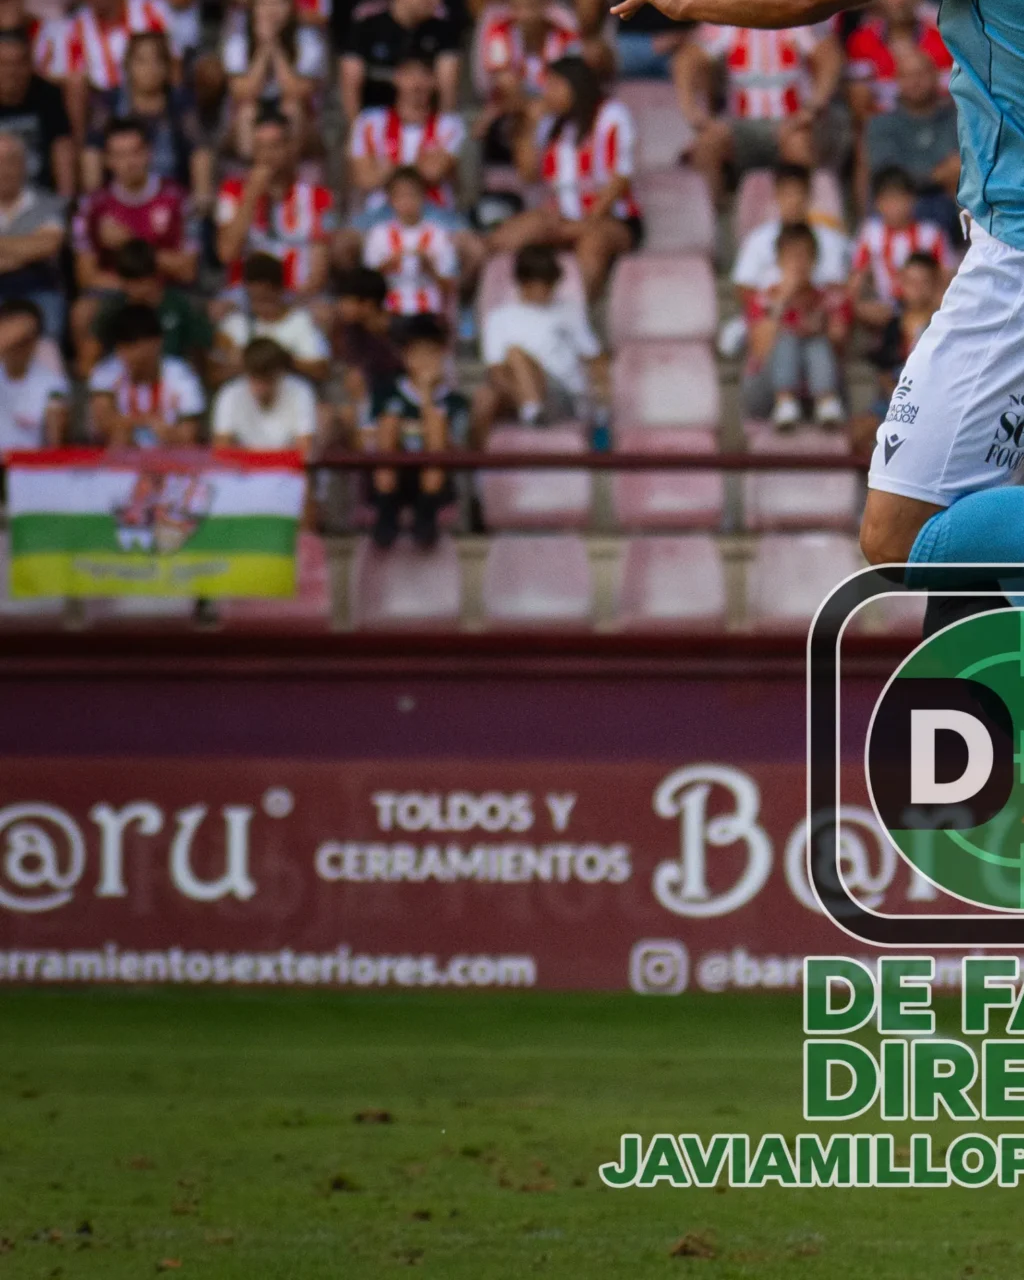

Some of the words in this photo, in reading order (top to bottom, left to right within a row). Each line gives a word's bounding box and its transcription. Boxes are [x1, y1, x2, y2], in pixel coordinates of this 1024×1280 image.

[371, 792, 534, 832] TOLDOS
[546, 793, 578, 831] Y
[315, 842, 632, 884] CERRAMIENTOS
